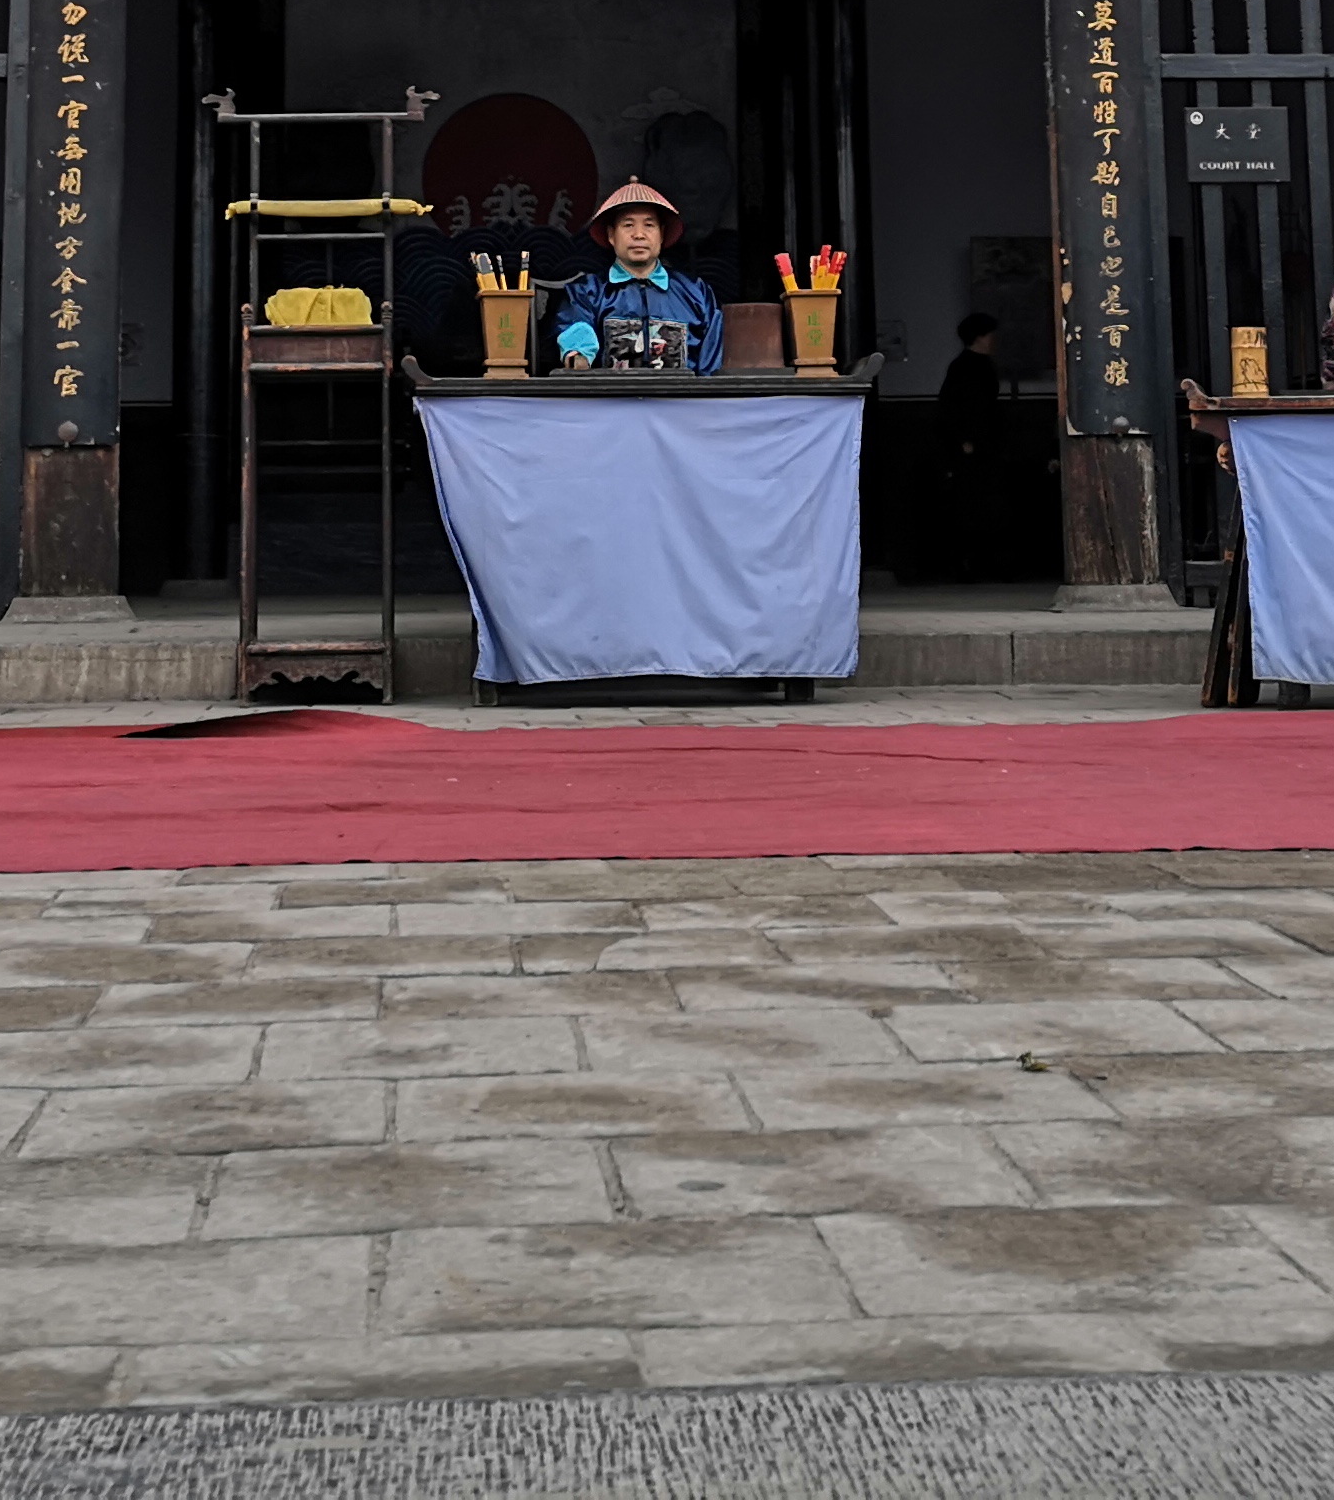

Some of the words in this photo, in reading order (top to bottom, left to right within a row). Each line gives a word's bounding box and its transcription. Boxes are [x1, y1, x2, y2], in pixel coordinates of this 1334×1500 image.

[1214, 122, 1262, 141] 大堂
[1199, 160, 1240, 171] COURT
[1246, 160, 1276, 171] HALL
